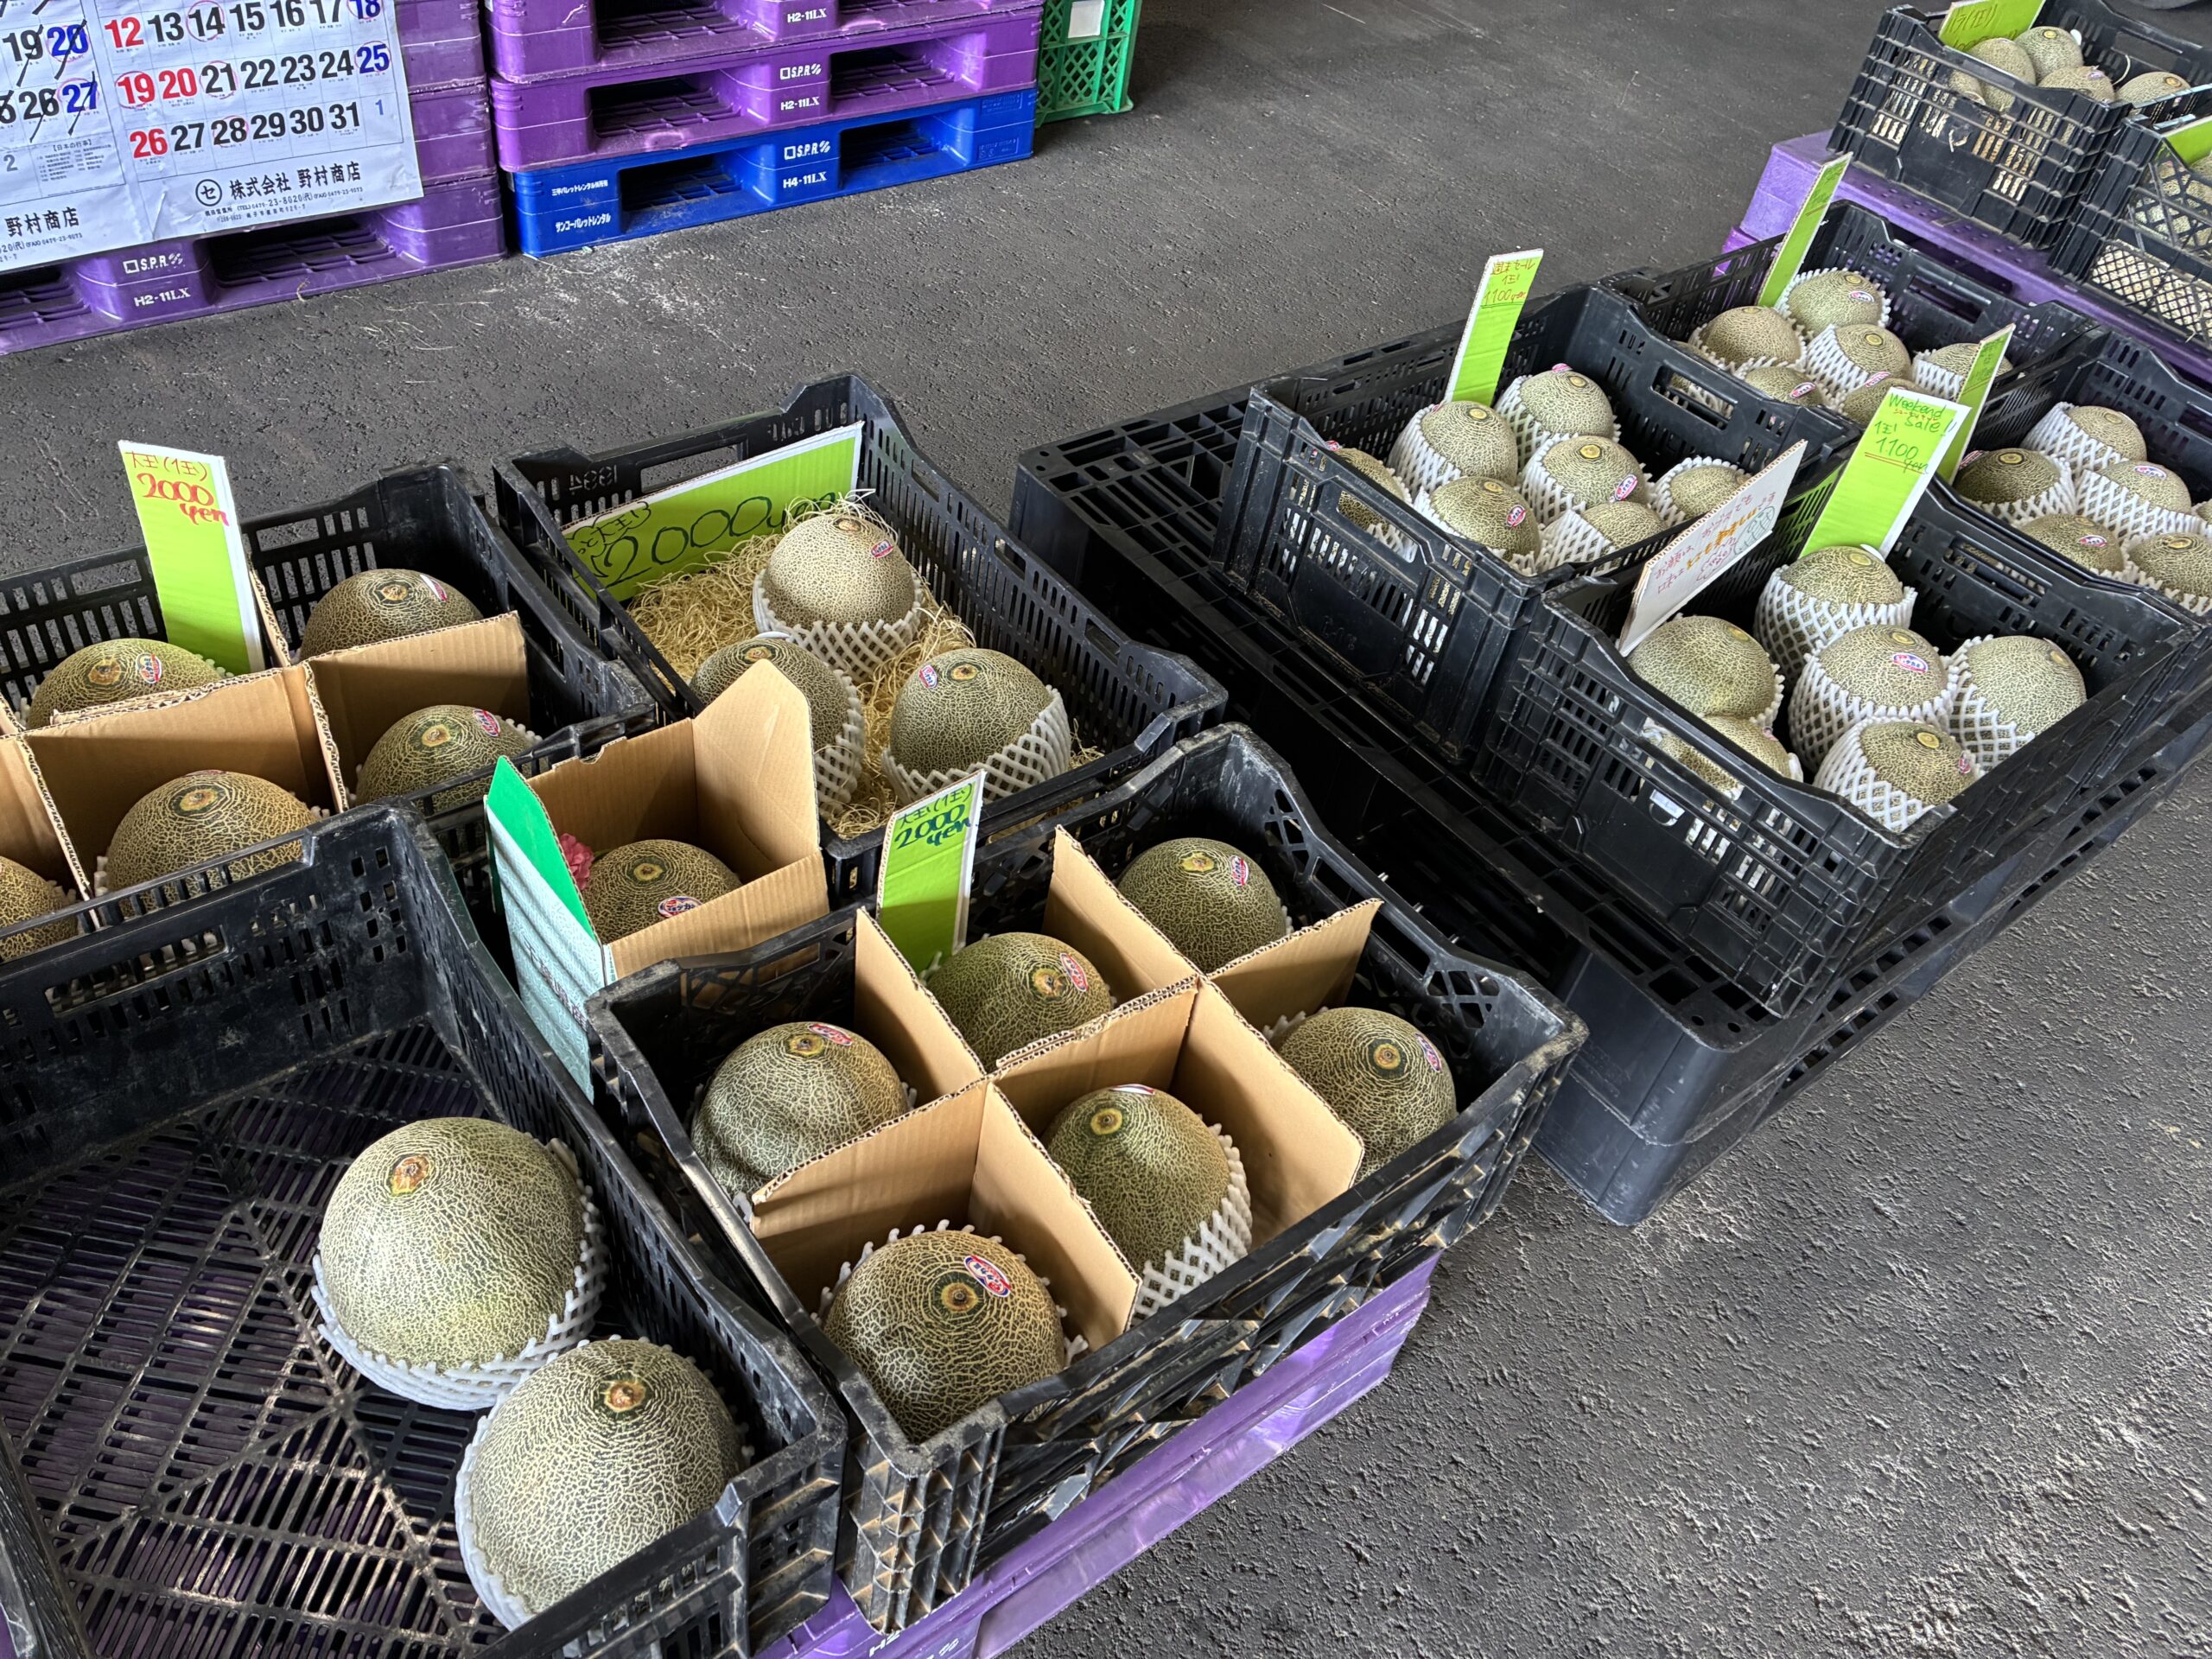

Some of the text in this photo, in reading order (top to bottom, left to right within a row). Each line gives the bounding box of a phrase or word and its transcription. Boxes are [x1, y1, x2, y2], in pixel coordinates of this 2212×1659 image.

[105, 0, 381, 48] 12 13 14 15 16 17 18
[787, 8, 828, 23] H2-11LX
[2, 24, 89, 62] 19 20
[118, 43, 390, 105] 19 20 21 22 23 24 25
[18, 88, 60, 120] 26
[62, 81, 98, 113] 27
[780, 97, 820, 111] H2-11LX
[130, 99, 385, 158] 26 27 28 29 30 31 1
[3, 154, 18, 172] 2
[229, 172, 292, 200] 株式会社
[296, 161, 361, 188] 野村商店
[783, 171, 827, 188] H4-11LX
[4, 207, 79, 238] 野村商店
[134, 288, 191, 307] H2-11LX
[1889, 392, 1948, 418] Weekend
[137, 473, 215, 506] 2000
[179, 504, 230, 526] yen
[894, 804, 965, 849] 2000
